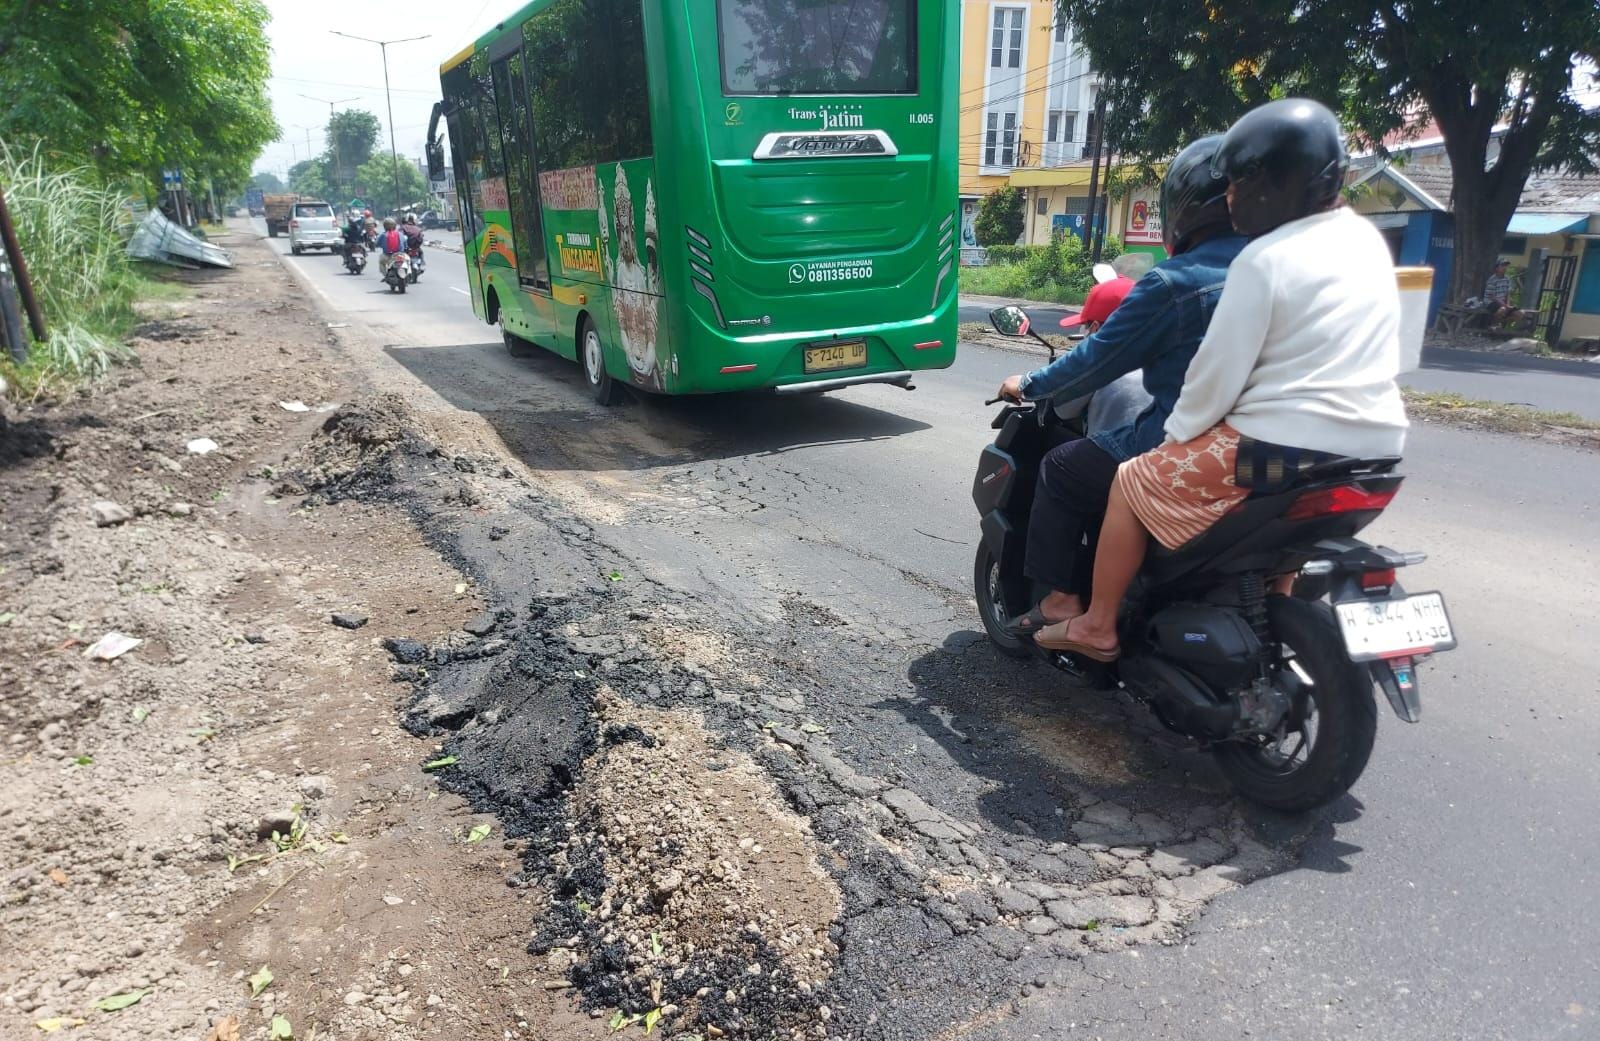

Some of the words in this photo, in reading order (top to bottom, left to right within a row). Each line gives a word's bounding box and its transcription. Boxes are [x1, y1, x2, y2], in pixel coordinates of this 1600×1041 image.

[787, 107, 816, 120] Trans
[819, 108, 864, 131] Jatim
[808, 262, 836, 270] LAYANAN
[836, 259, 873, 268] PENGADUAN
[808, 267, 873, 282] 0811356500
[806, 351, 813, 364] S
[851, 345, 864, 358] UP
